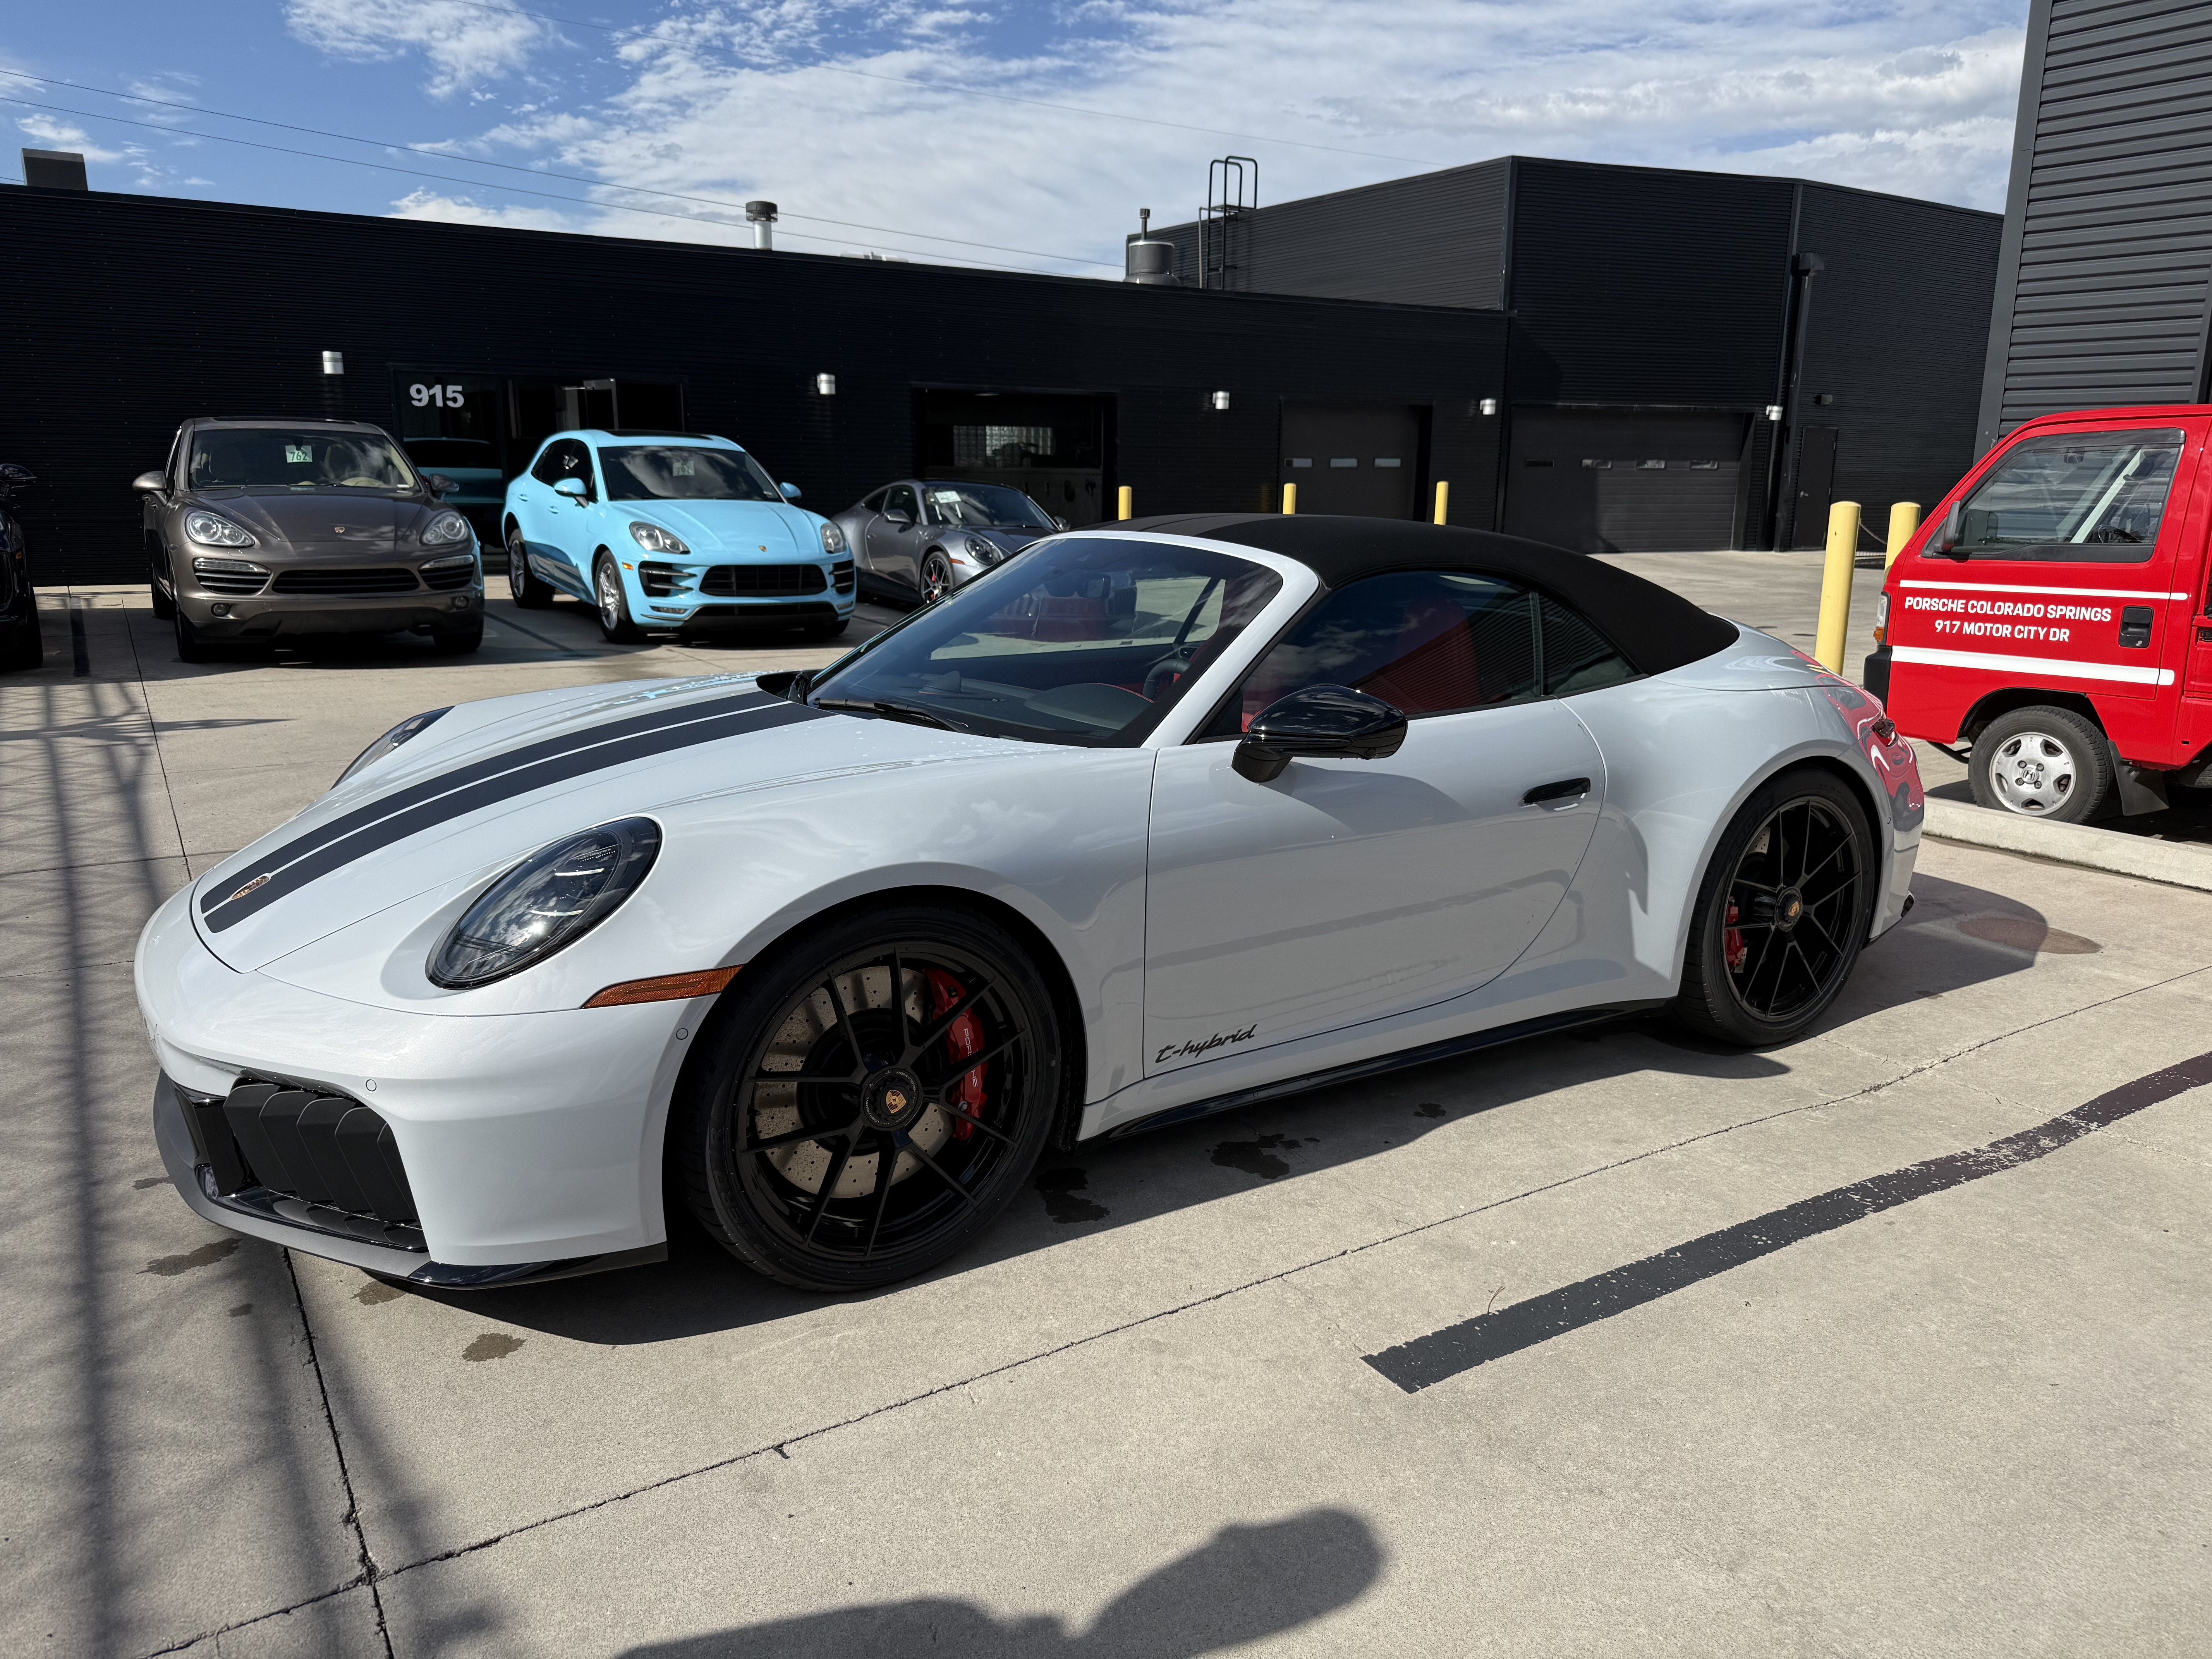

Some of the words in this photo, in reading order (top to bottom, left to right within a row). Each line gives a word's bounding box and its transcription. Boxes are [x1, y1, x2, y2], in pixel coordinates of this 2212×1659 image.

[410, 384, 464, 408] 915
[291, 452, 307, 461] 762
[1905, 596, 1966, 612] PORSCHE
[1968, 600, 2044, 617] COLORADO
[2046, 605, 2112, 622] SPRINGS
[1935, 619, 1961, 634] 917
[1962, 622, 2012, 637] MOTOR
[2014, 625, 2048, 640] CITY
[2049, 628, 2070, 642] DR
[1155, 1024, 1258, 1063] t-hybrid
[963, 1028, 978, 1087] PORHE
